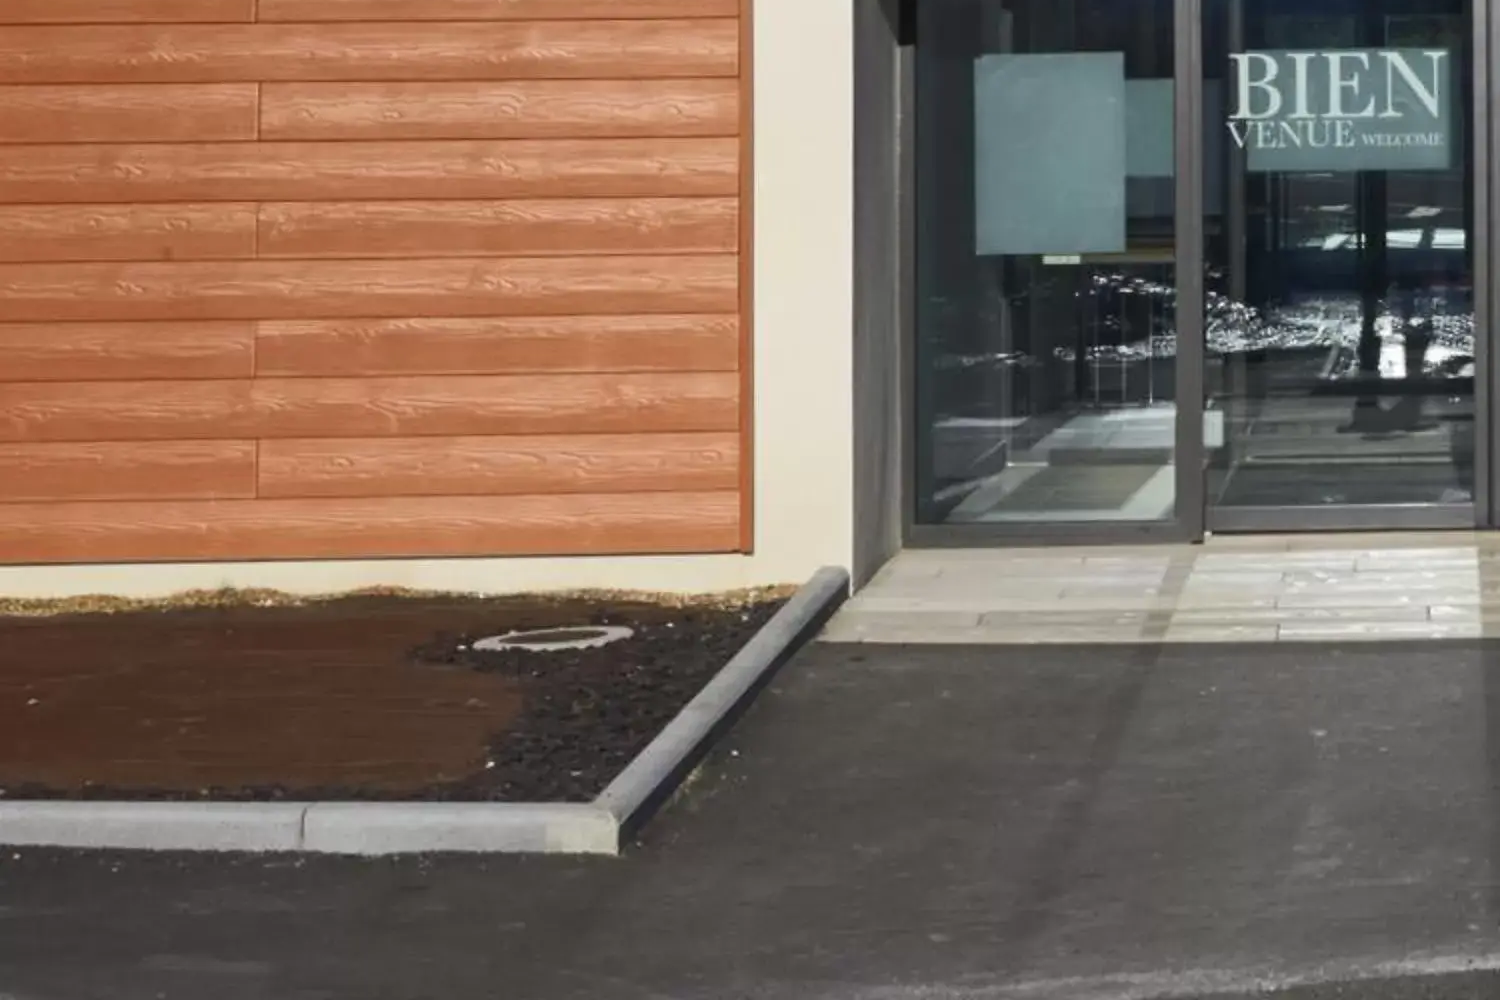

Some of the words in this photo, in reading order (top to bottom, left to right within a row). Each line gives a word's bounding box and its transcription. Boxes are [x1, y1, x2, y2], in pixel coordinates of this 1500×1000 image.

[1228, 51, 1448, 120] BIEN
[1226, 119, 1355, 150] VENUE
[1361, 131, 1444, 147] WELCOME
